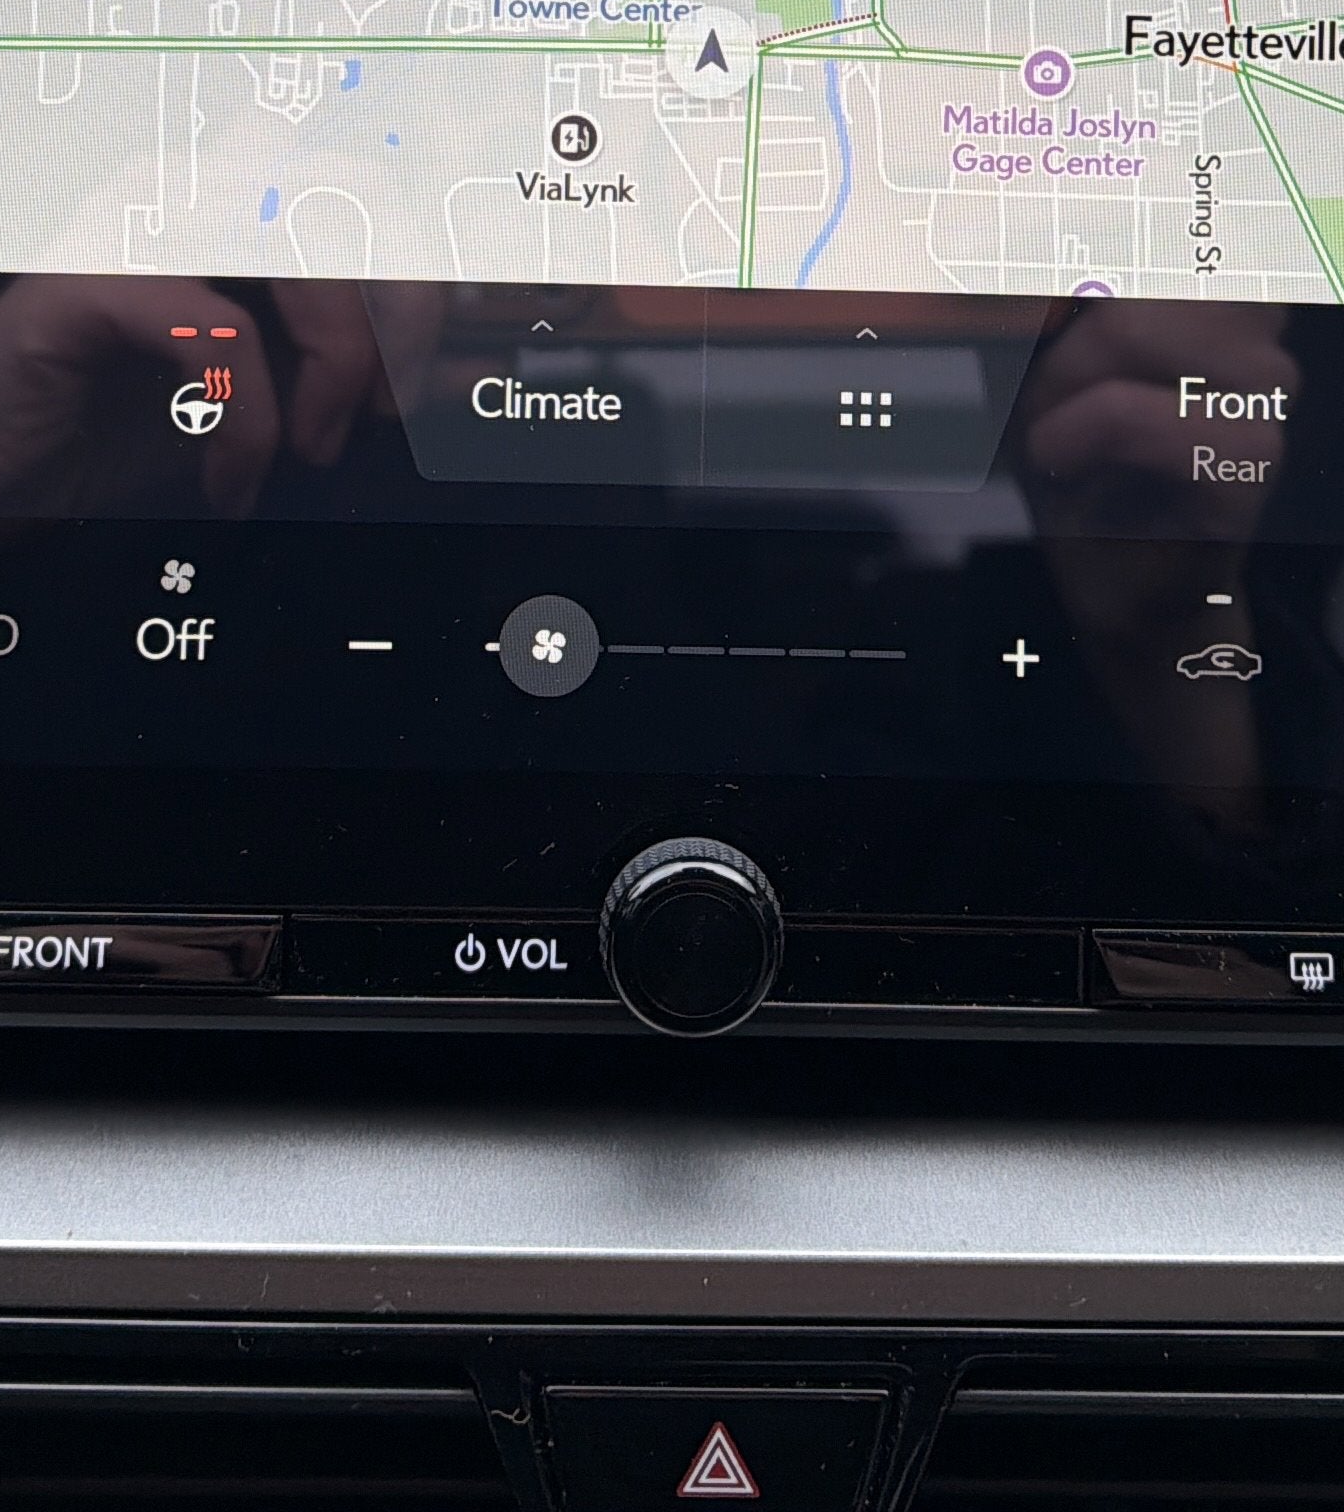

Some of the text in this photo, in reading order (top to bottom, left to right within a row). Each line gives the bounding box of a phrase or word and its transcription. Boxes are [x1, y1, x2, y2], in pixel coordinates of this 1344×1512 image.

[942, 105, 1156, 140] Matilda Joslyn
[952, 143, 1145, 181] Gage Center
[516, 171, 636, 205] ViaLynk
[1189, 155, 1220, 276] Spring St
[471, 377, 623, 423] Climate
[1177, 377, 1288, 422] Front
[1192, 446, 1272, 485] Rear
[137, 618, 214, 661] Off
[497, 938, 568, 972] VOL
